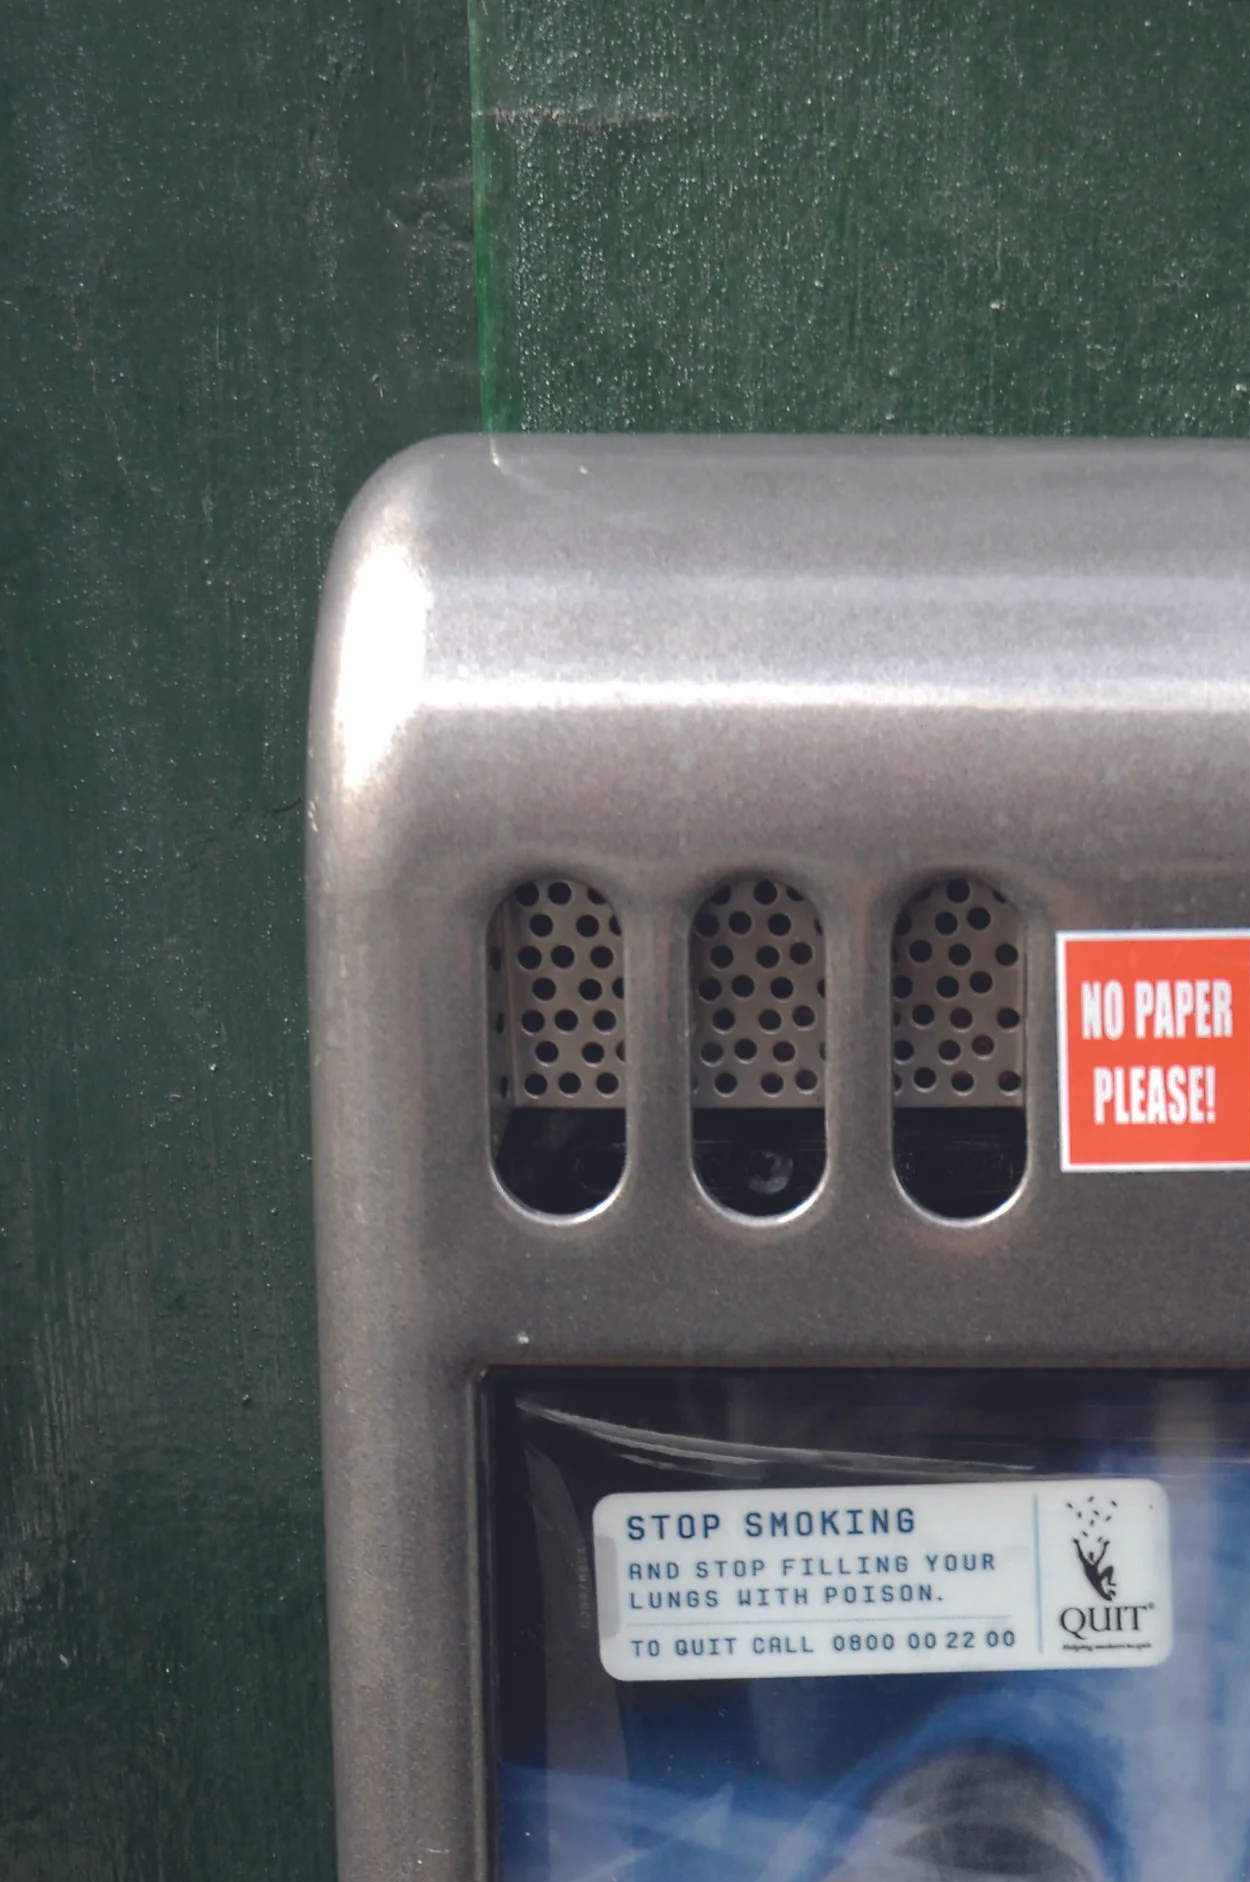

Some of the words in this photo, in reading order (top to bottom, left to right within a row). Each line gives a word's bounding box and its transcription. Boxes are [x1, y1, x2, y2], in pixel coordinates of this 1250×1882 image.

[1081, 980, 1124, 1040] NO
[1134, 979, 1233, 1039] PAPER
[1093, 1064, 1216, 1124] PLEASE!
[627, 1513, 721, 1541] STOP
[744, 1507, 915, 1538] SMOKING
[628, 1561, 680, 1581] AND
[695, 1559, 765, 1579] STOP
[782, 1555, 909, 1577] FILLING
[925, 1552, 995, 1572] YOUR
[630, 1589, 719, 1610] LUNGS
[737, 1587, 808, 1607] WITH
[824, 1583, 943, 1604] POISON.
[631, 1639, 660, 1657] TO
[674, 1637, 737, 1657] QUIT
[752, 1635, 814, 1655] CALL
[832, 1633, 895, 1652] 0800
[907, 1632, 937, 1651] 00
[946, 1630, 975, 1649] 22
[985, 1629, 1016, 1648] 00
